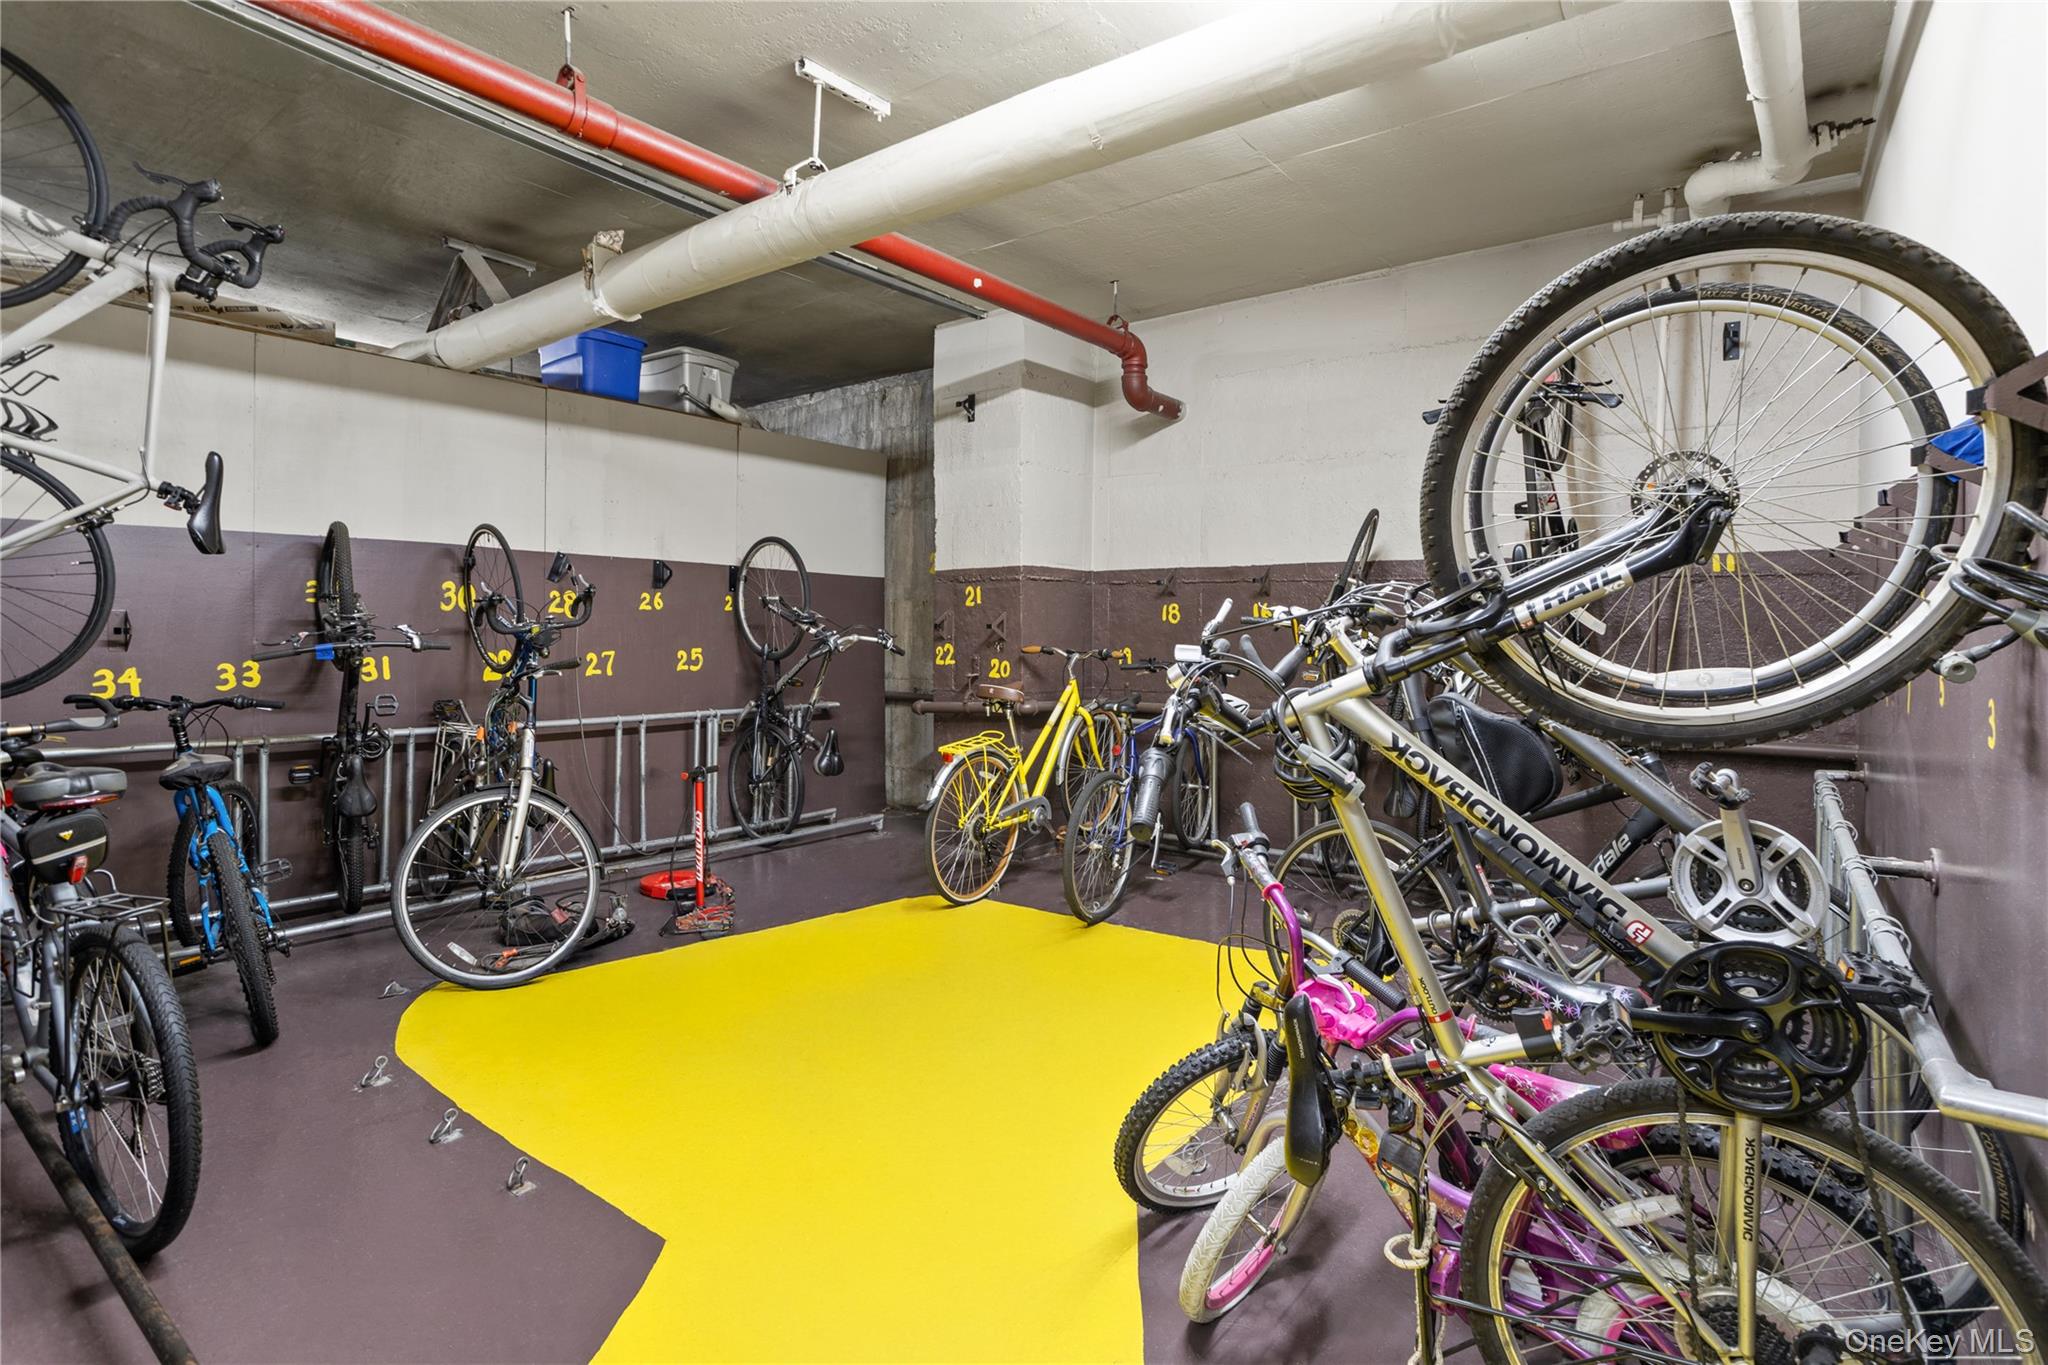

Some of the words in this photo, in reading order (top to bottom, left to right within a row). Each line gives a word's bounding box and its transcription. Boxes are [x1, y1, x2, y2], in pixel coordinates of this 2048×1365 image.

[439, 580, 477, 613] 30
[965, 585, 982, 607] 21
[1604, 580, 1625, 594] XC
[548, 590, 577, 619] 28
[638, 592, 664, 612] 26
[724, 595, 733, 611] 2
[1161, 602, 1182, 625] 18
[585, 650, 616, 677] 27
[676, 647, 704, 673] 25
[935, 643, 956, 666] 22
[216, 660, 262, 691] 33
[361, 655, 391, 682] 31
[988, 658, 1011, 679] 20
[90, 667, 141, 699] 34
[1472, 669, 1563, 732] SPCIALIZED
[1382, 732, 1628, 922] DIAMONDBACK
[1418, 977, 1438, 1015] OUTLOOK
[1743, 1137, 1756, 1242] DIAMONDBACK
